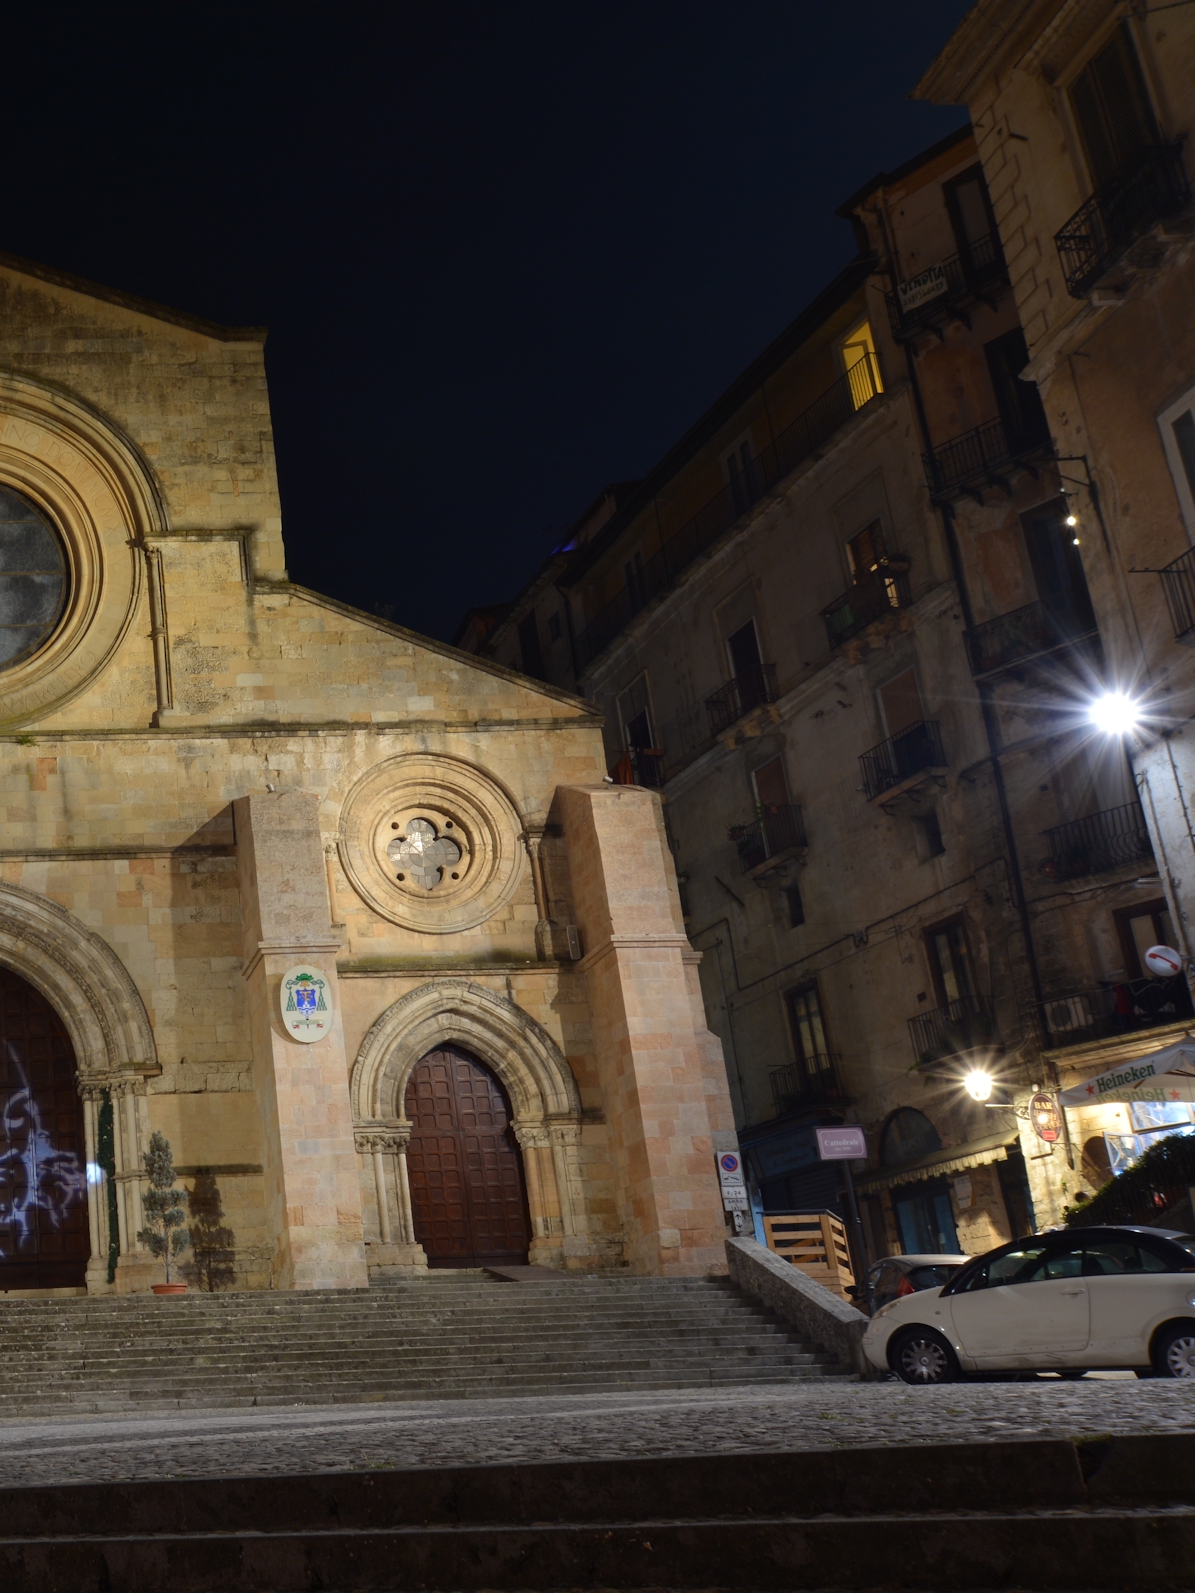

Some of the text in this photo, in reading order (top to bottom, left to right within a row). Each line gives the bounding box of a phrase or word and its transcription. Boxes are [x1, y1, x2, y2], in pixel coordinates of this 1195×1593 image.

[900, 265, 945, 296] VENDITA
[1096, 1064, 1156, 1093] Heineken
[1034, 1101, 1054, 1110] BAR
[824, 1138, 859, 1147] Cattedrale
